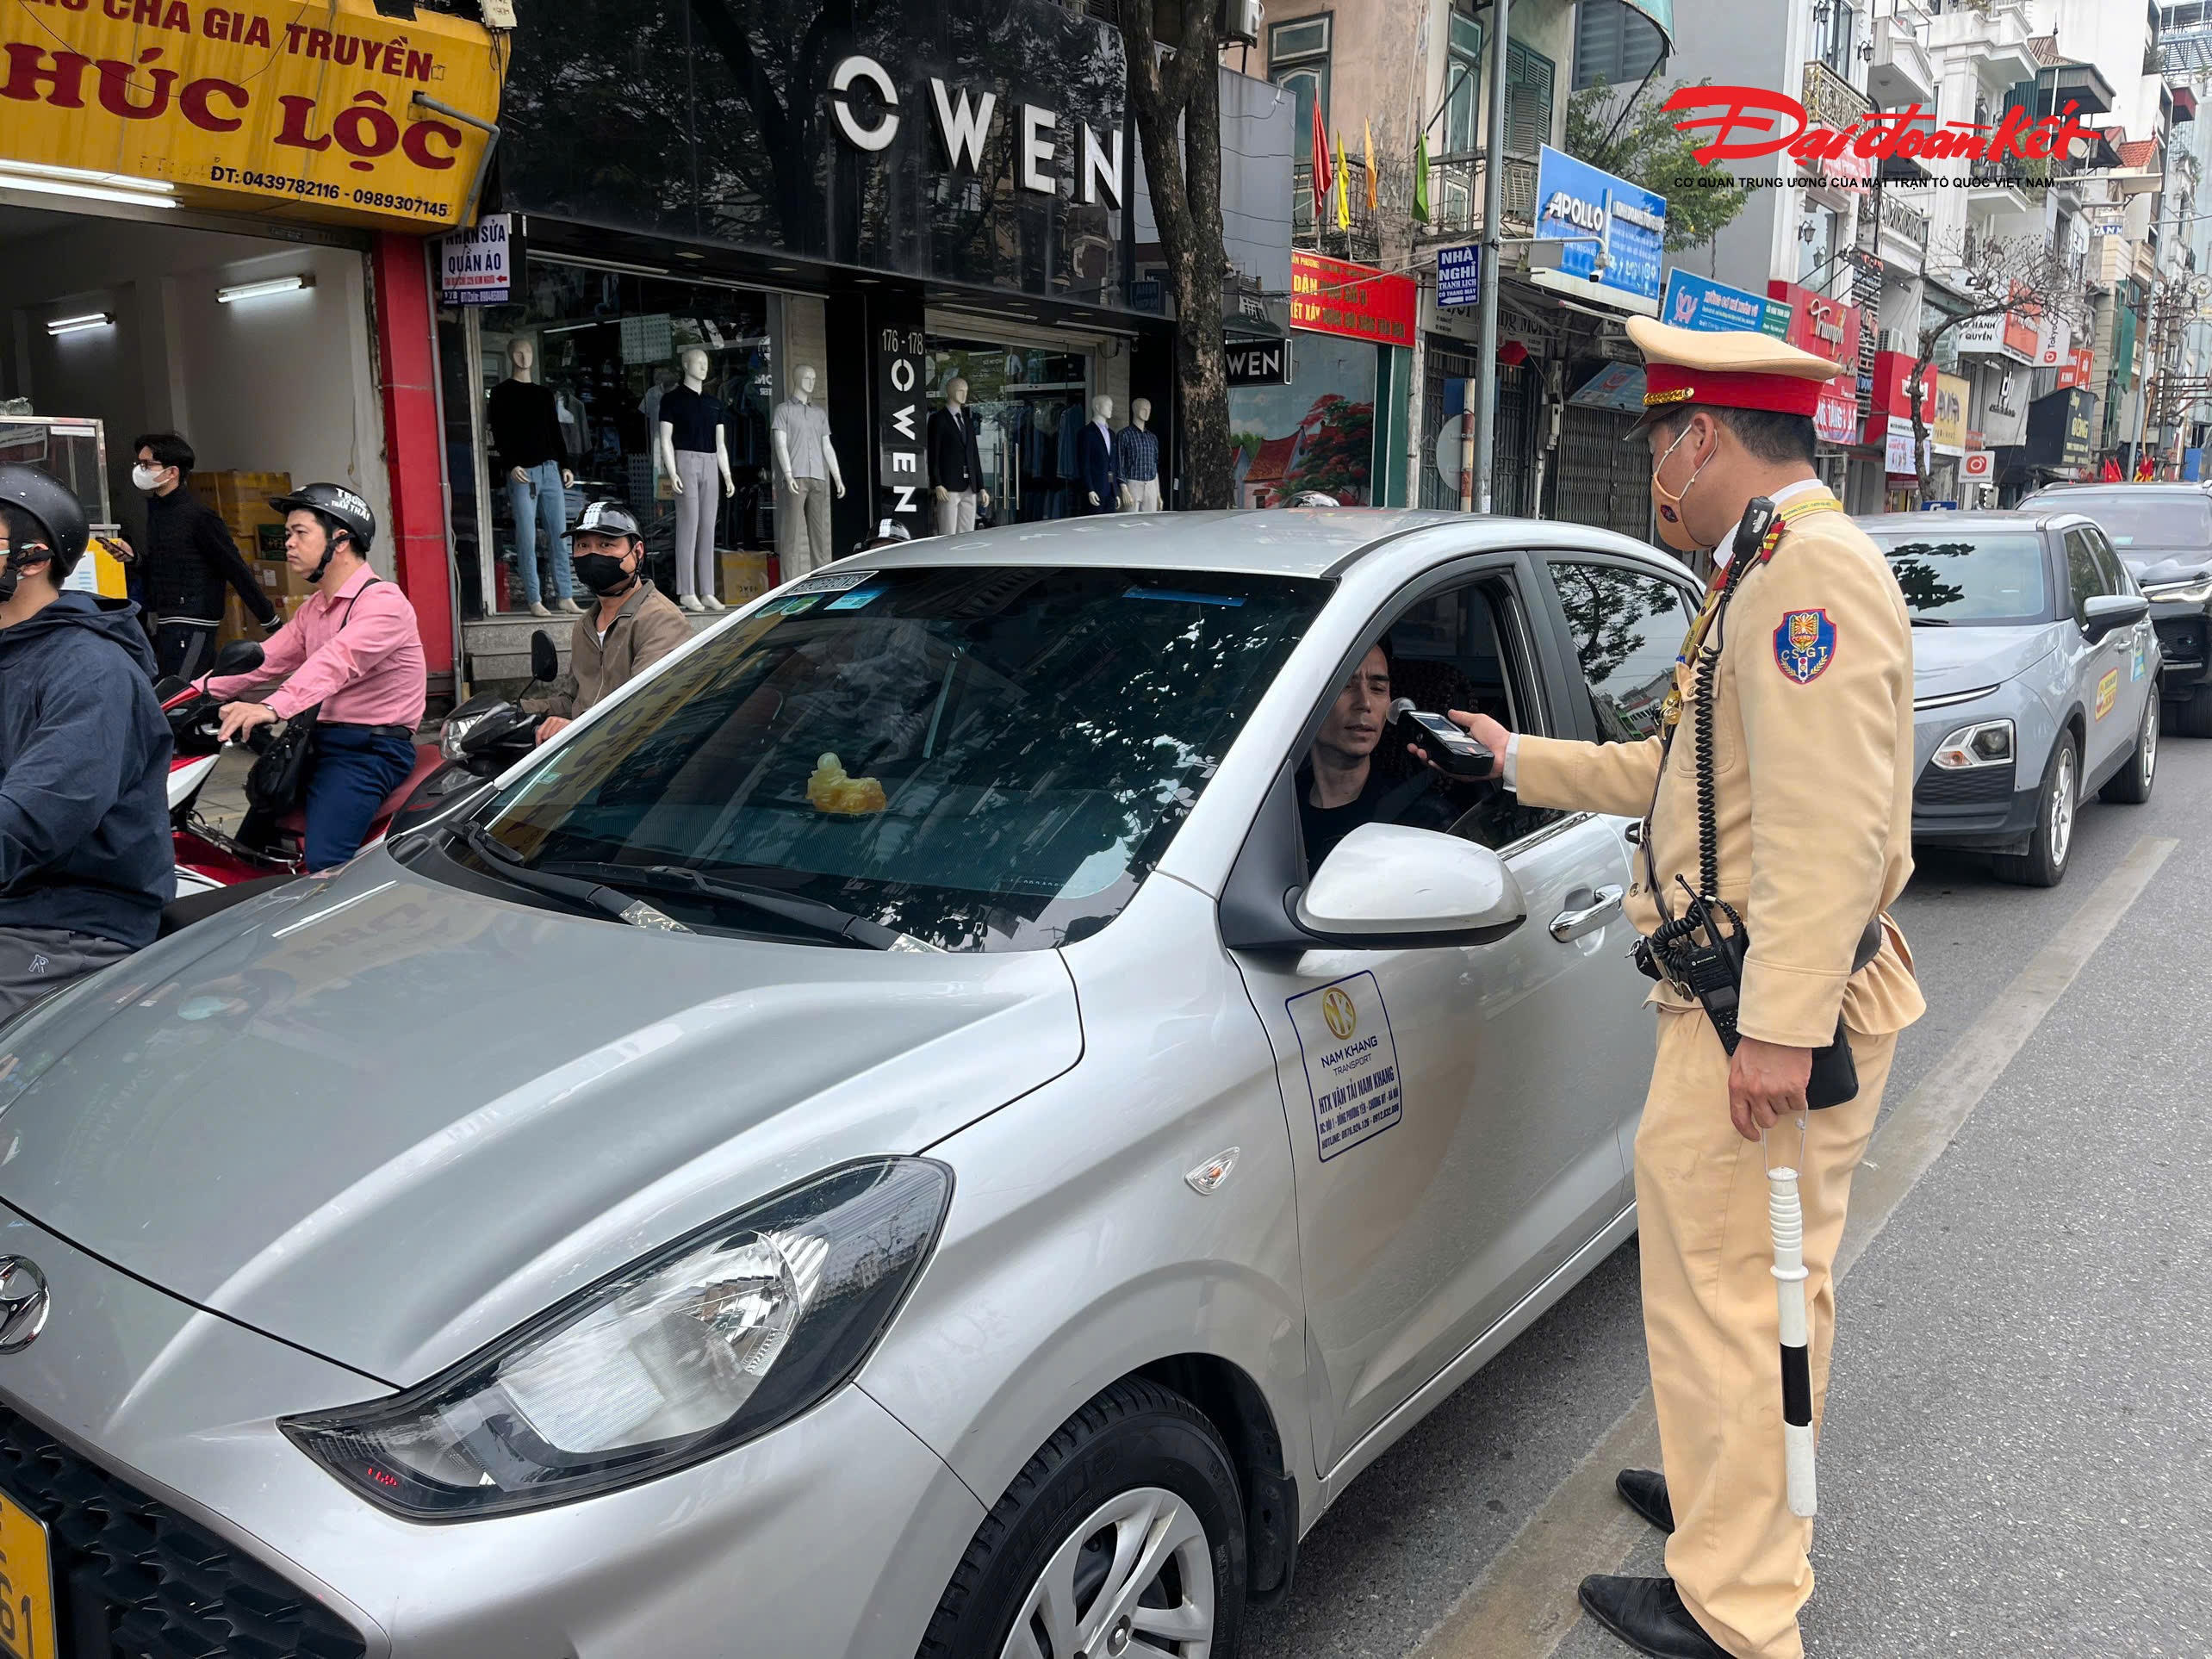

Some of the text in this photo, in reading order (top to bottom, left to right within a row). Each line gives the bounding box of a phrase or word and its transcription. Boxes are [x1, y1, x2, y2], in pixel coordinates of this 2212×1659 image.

[202, 14, 271, 49] GIA
[286, 23, 434, 82] TRUYỀN
[272, 90, 463, 172] LỘC
[828, 54, 1122, 211] OWEN
[242, 170, 340, 199] 0439782116
[353, 189, 449, 217] 0989307145
[1549, 191, 1604, 232] APOLLO
[481, 219, 506, 243] SỬA
[448, 248, 501, 275] QUẦN ÁO
[1441, 246, 1474, 265] NHÀ
[1293, 273, 1318, 296] DÂN
[1438, 261, 1477, 282] NGHỈ
[882, 328, 899, 352] 176
[908, 332, 923, 355] 178
[1224, 350, 1280, 376] WEN
[891, 358, 917, 513] OWEN
[1320, 1035, 1378, 1068] NAM KHANG
[1333, 1053, 1372, 1076] TRANSPORT
[1318, 1066, 1395, 1115] HTX VẬN TẢI NAM KHANG
